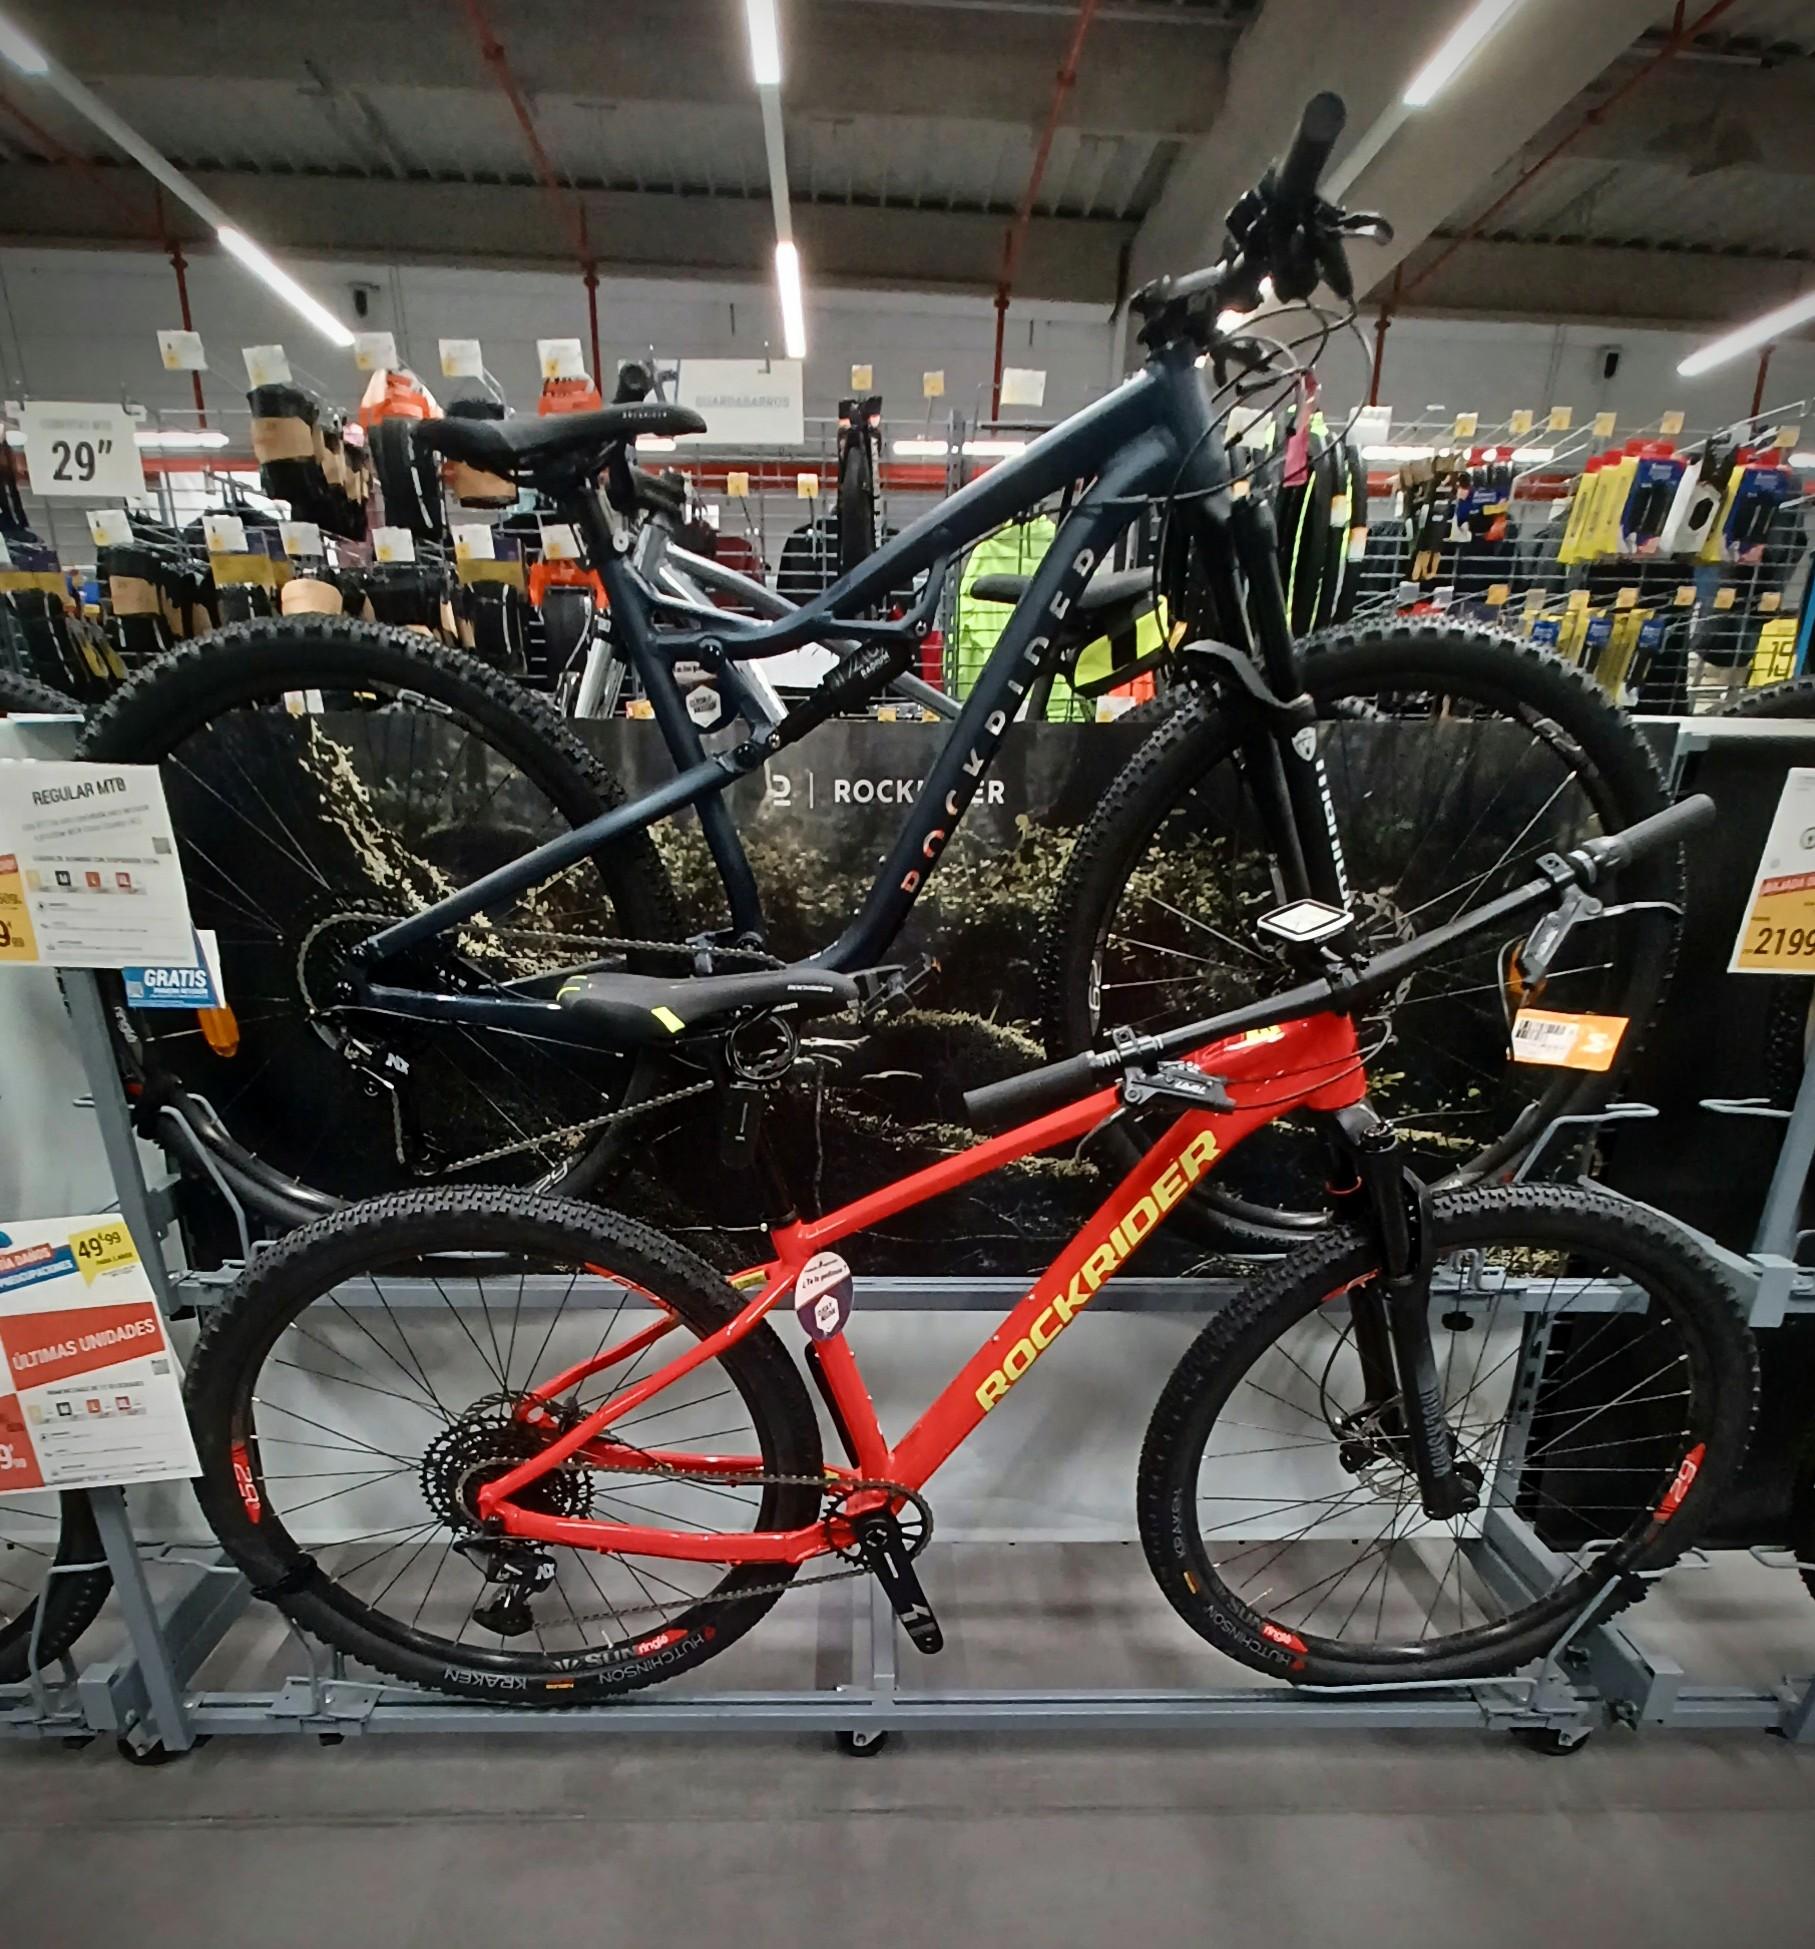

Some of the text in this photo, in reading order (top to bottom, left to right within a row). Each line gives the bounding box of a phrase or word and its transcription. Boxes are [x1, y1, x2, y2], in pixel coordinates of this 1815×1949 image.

[32, 777, 126, 806] REGULAR MTB
[143, 968, 207, 988] GRATIS
[975, 1130, 1221, 1411] ROCKRIDER
[12, 1318, 156, 1371] ÚLTIMAS UNIDADES
[1672, 1459, 1697, 1504] 29
[599, 1631, 705, 1685] HUTCHINSON
[1205, 1604, 1291, 1665] HUTCHINSON
[444, 1668, 527, 1690] KRAKEN
